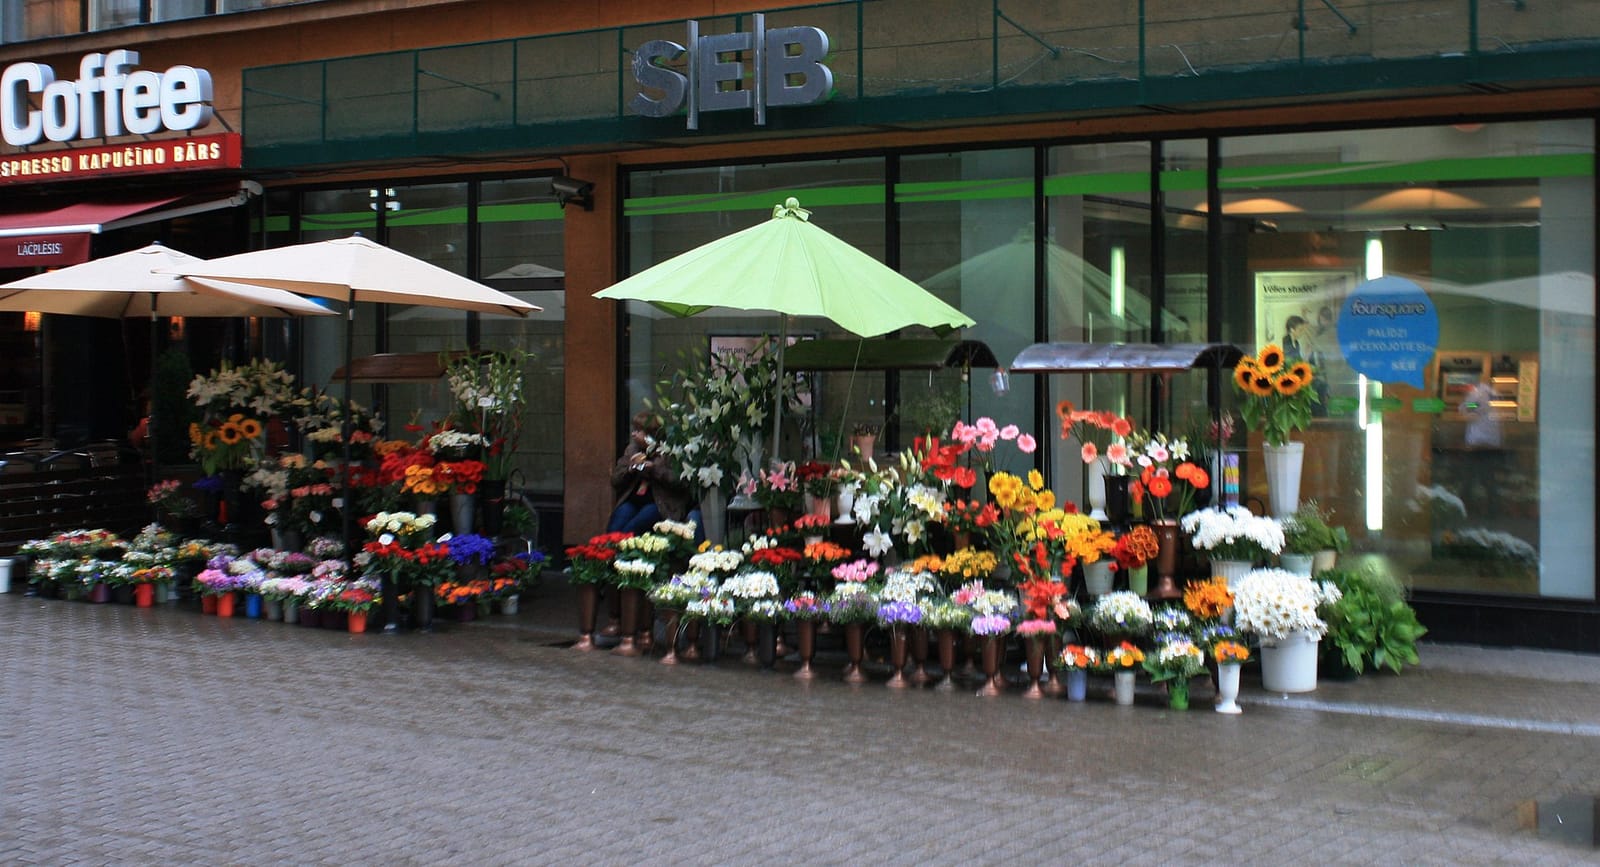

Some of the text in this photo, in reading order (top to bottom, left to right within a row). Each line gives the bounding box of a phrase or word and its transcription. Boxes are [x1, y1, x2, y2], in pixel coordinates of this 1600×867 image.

[0, 49, 213, 146] Coffee
[627, 25, 834, 119] SEB
[0, 142, 221, 177] SPRESSO KAPUČĪNO BĀRS
[1352, 299, 1426, 319] foursquare
